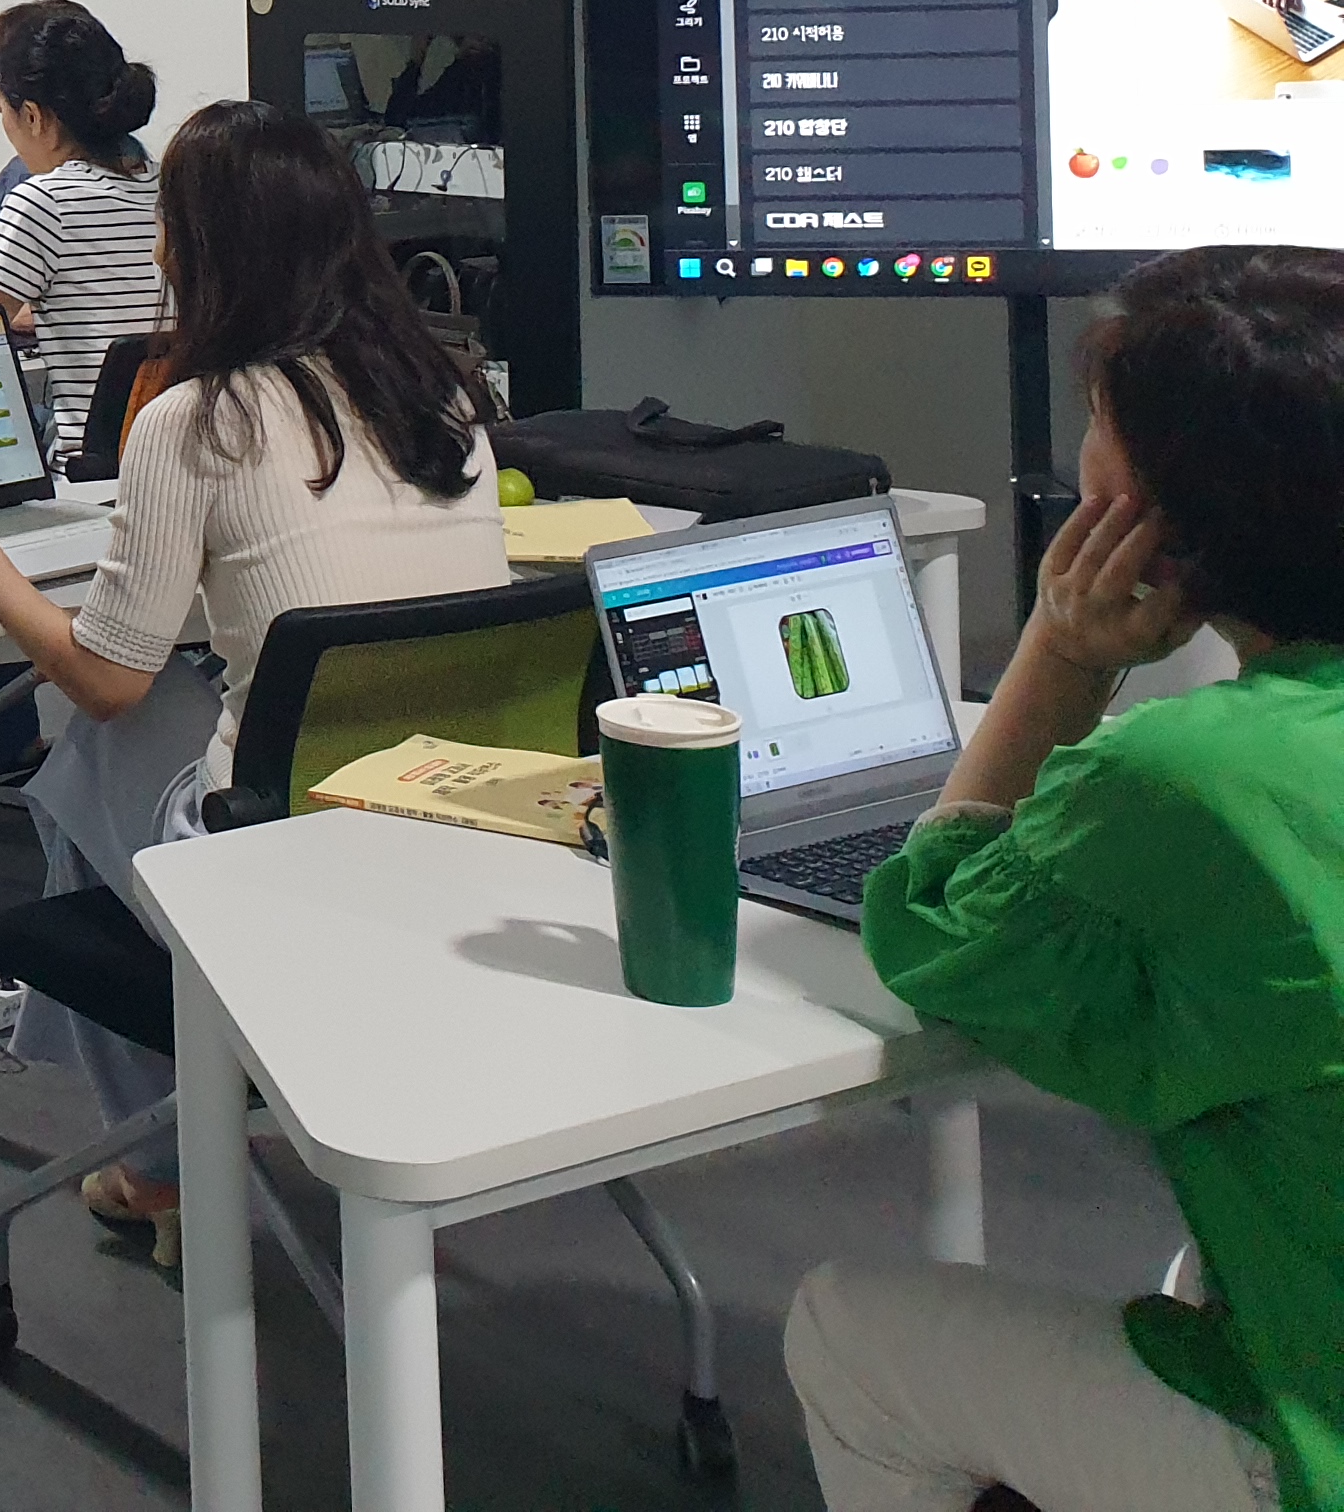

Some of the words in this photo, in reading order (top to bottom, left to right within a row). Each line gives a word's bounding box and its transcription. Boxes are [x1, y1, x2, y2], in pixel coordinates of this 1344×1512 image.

[761, 27, 789, 41] 210
[762, 73, 782, 89] 210
[764, 119, 795, 136] 210
[765, 166, 793, 181] 210
[796, 166, 842, 182] 햄스터
